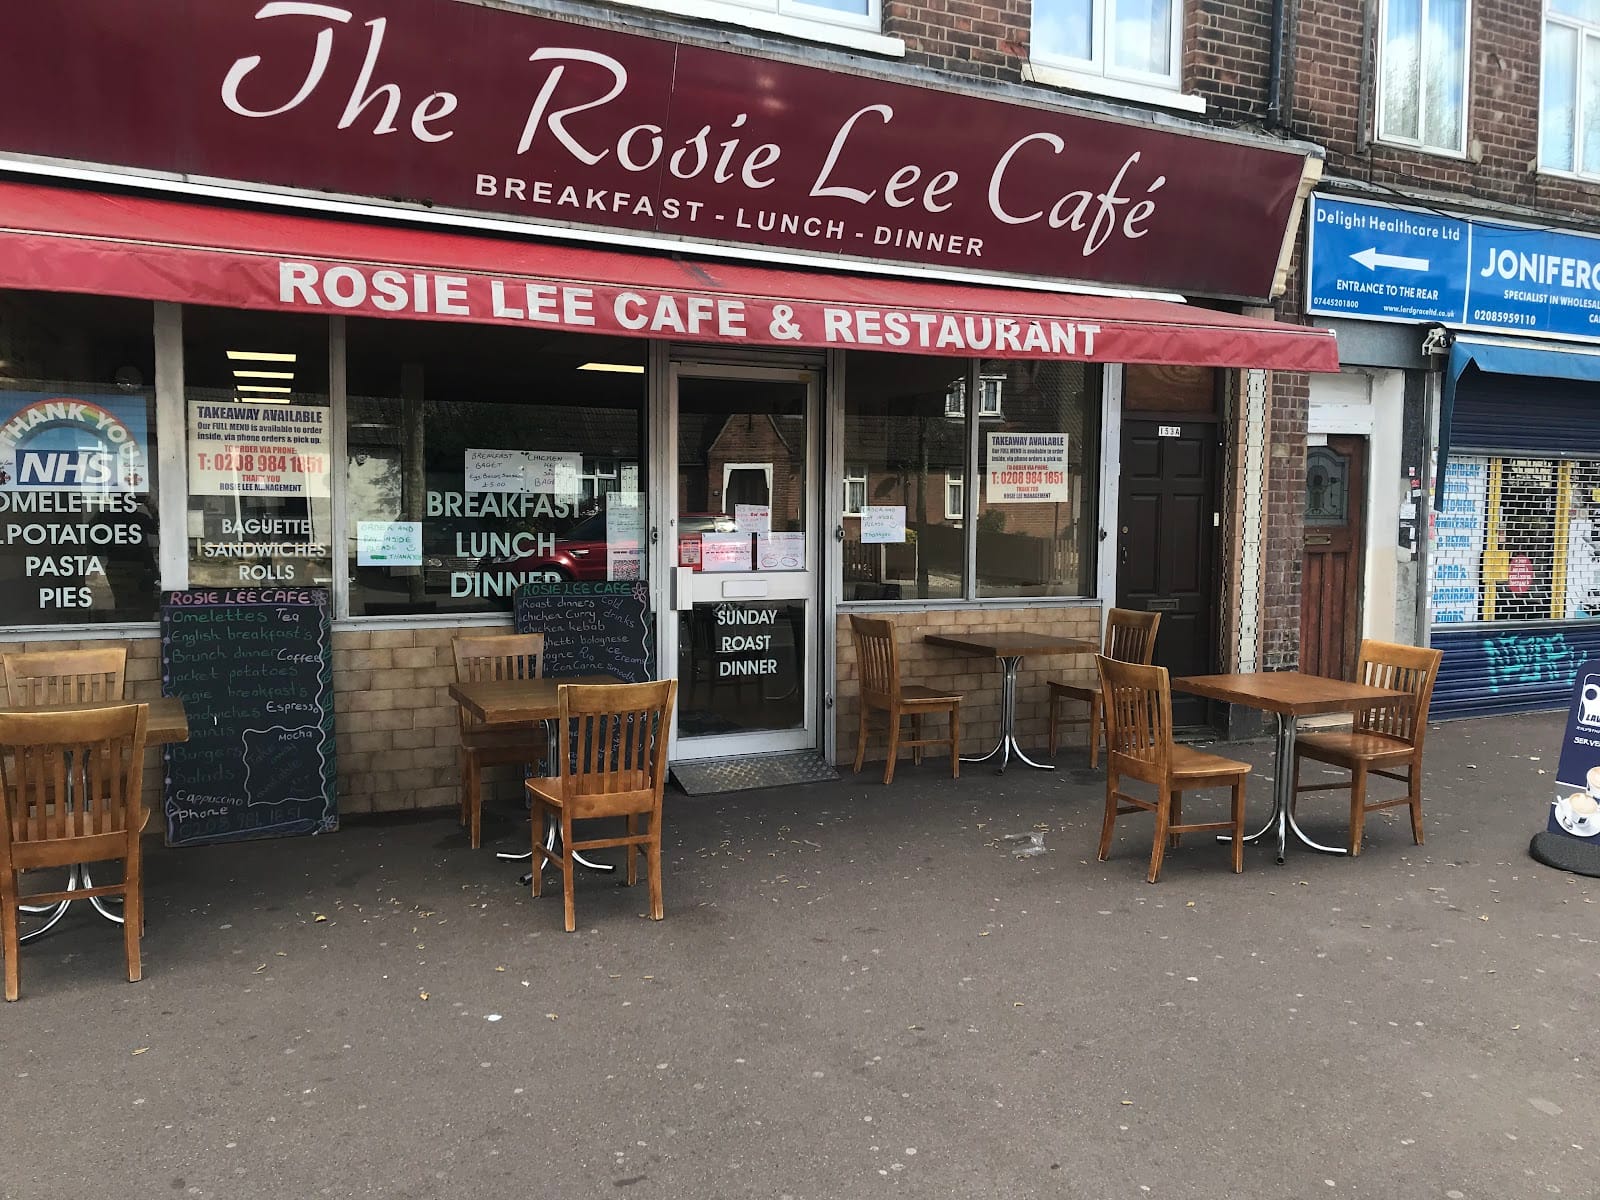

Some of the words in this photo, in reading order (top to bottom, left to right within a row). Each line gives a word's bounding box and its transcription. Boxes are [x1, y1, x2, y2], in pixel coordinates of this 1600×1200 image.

[221, 1, 458, 142] The
[517, 47, 781, 189] Rosie
[809, 104, 959, 213] Lee
[988, 132, 1166, 257] Café
[475, 174, 704, 222] BREAKFAST
[736, 208, 845, 240] LUNCH
[874, 226, 984, 257] DINNER
[1317, 208, 1366, 230] Delight
[1369, 216, 1439, 239] Healthcare
[1442, 227, 1460, 241] Ltd
[1336, 279, 1384, 295] ENTRANCE
[1386, 284, 1398, 296] TO
[1399, 286, 1415, 299] THE
[1417, 288, 1439, 301] REAR
[1503, 289, 1548, 304] SPECIALIST
[1549, 295, 1559, 304] IN
[279, 261, 470, 316] ROSIE
[491, 280, 596, 326] LEE
[613, 292, 747, 337] CAFE
[768, 304, 803, 341] &
[824, 308, 1102, 356] RESTAURANT
[1474, 309, 1536, 326] 02085959110
[197, 406, 260, 421] TAKEAWAY
[262, 409, 323, 424] AVAILABLE
[0, 402, 88, 448] THANK
[95, 411, 140, 461] YOU
[197, 421, 211, 431] Our
[212, 422, 228, 431] FULL
[229, 423, 250, 432] MENU
[259, 424, 293, 433] available
[294, 425, 302, 433] to
[302, 426, 323, 434] order
[236, 434, 257, 443] phone
[261, 434, 286, 443] orders
[293, 436, 309, 444] pick
[991, 436, 1028, 446] TAKEAWAY
[1028, 436, 1064, 446] AVAILABLE
[20, 452, 113, 484] NHS
[197, 453, 212, 471] T:
[257, 455, 287, 473] 984
[991, 472, 1000, 485] T:
[1001, 472, 1024, 485] 0208
[254, 484, 302, 492] MNAGEMENT
[426, 491, 580, 519] BREAKFAST
[222, 518, 312, 535] BAGUETTE
[204, 541, 327, 558] SANDWICHES
[456, 531, 556, 558] LUNCH
[25, 555, 107, 578] PASTA
[239, 564, 295, 581] ROLLS
[39, 586, 94, 609] PIES
[224, 591, 258, 604] LEE
[260, 590, 311, 604] CAFE
[523, 583, 561, 597] ROSIE
[564, 584, 592, 596] LEE
[593, 583, 633, 596] CAFE
[522, 598, 553, 609] Roast
[556, 597, 596, 608] dinners
[601, 596, 624, 610] Cold
[172, 608, 269, 623] Omelettes
[275, 608, 300, 622] Tea
[602, 608, 635, 628] drinks
[716, 609, 778, 626] SUNDAY
[523, 622, 565, 634] chicken
[568, 619, 606, 632] kebab
[171, 628, 222, 648] English
[580, 634, 631, 647] bolognese
[721, 635, 772, 652] ROAST
[172, 645, 228, 664] Brunch
[277, 648, 322, 664] Coffee
[228, 663, 299, 686] potatoes
[719, 660, 778, 677] DINNER
[186, 704, 262, 720] andwiches
[266, 701, 320, 714] Espresso
[278, 730, 313, 742] Mocha
[175, 789, 244, 807] Cappuccino
